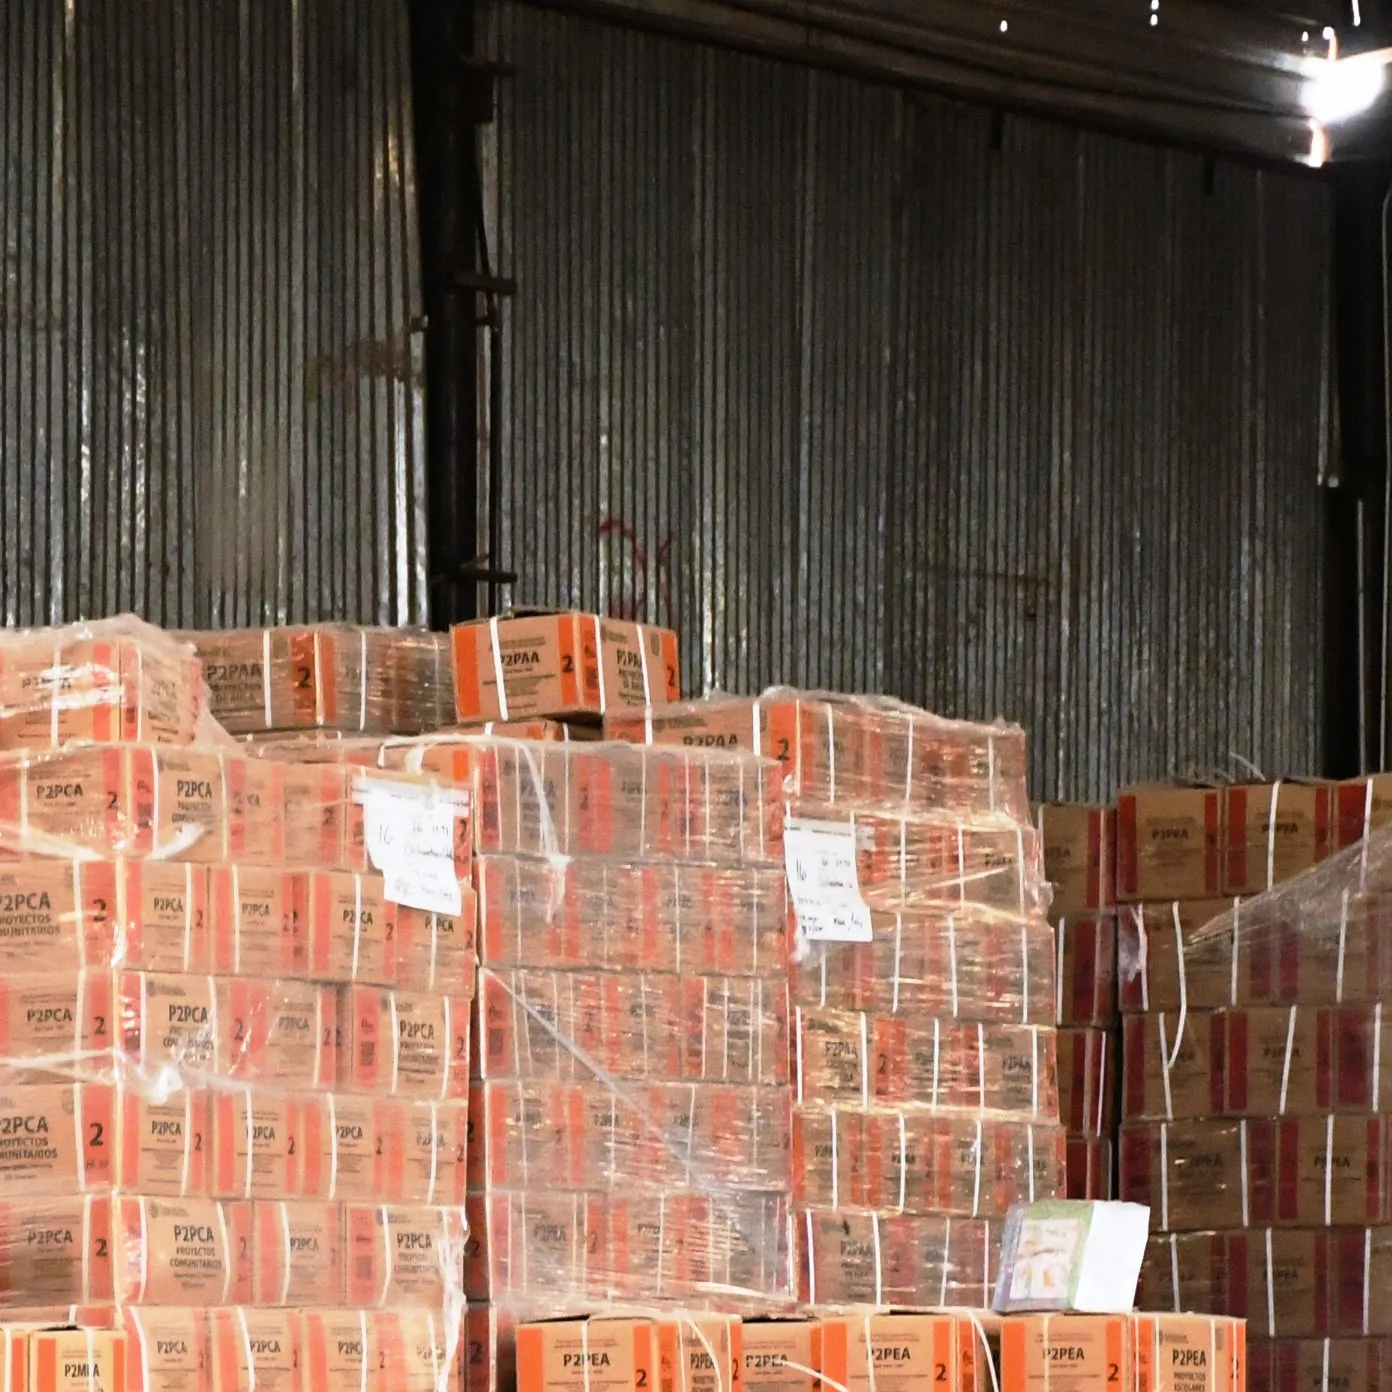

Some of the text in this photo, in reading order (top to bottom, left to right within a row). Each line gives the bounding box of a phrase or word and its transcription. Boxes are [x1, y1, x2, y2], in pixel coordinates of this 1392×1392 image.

[208, 664, 262, 680] P2PAA
[563, 655, 573, 673] 2
[297, 665, 311, 688] 2
[37, 783, 83, 799] P2PCA
[177, 780, 212, 798] P2PCA
[92, 899, 106, 922] 2
[153, 897, 183, 913] P2PCA
[27, 1007, 72, 1023] P2PCA
[169, 1005, 208, 1024] P2PCA
[400, 1020, 433, 1040] P2PCA
[90, 1123, 103, 1146] 2
[152, 1120, 182, 1136] P2PCA
[174, 1225, 214, 1243] P2PCA
[397, 1233, 432, 1249] P2PCA
[1172, 1348, 1206, 1366] P2PEA
[636, 1369, 647, 1387] 2
[935, 1364, 946, 1381] 2
